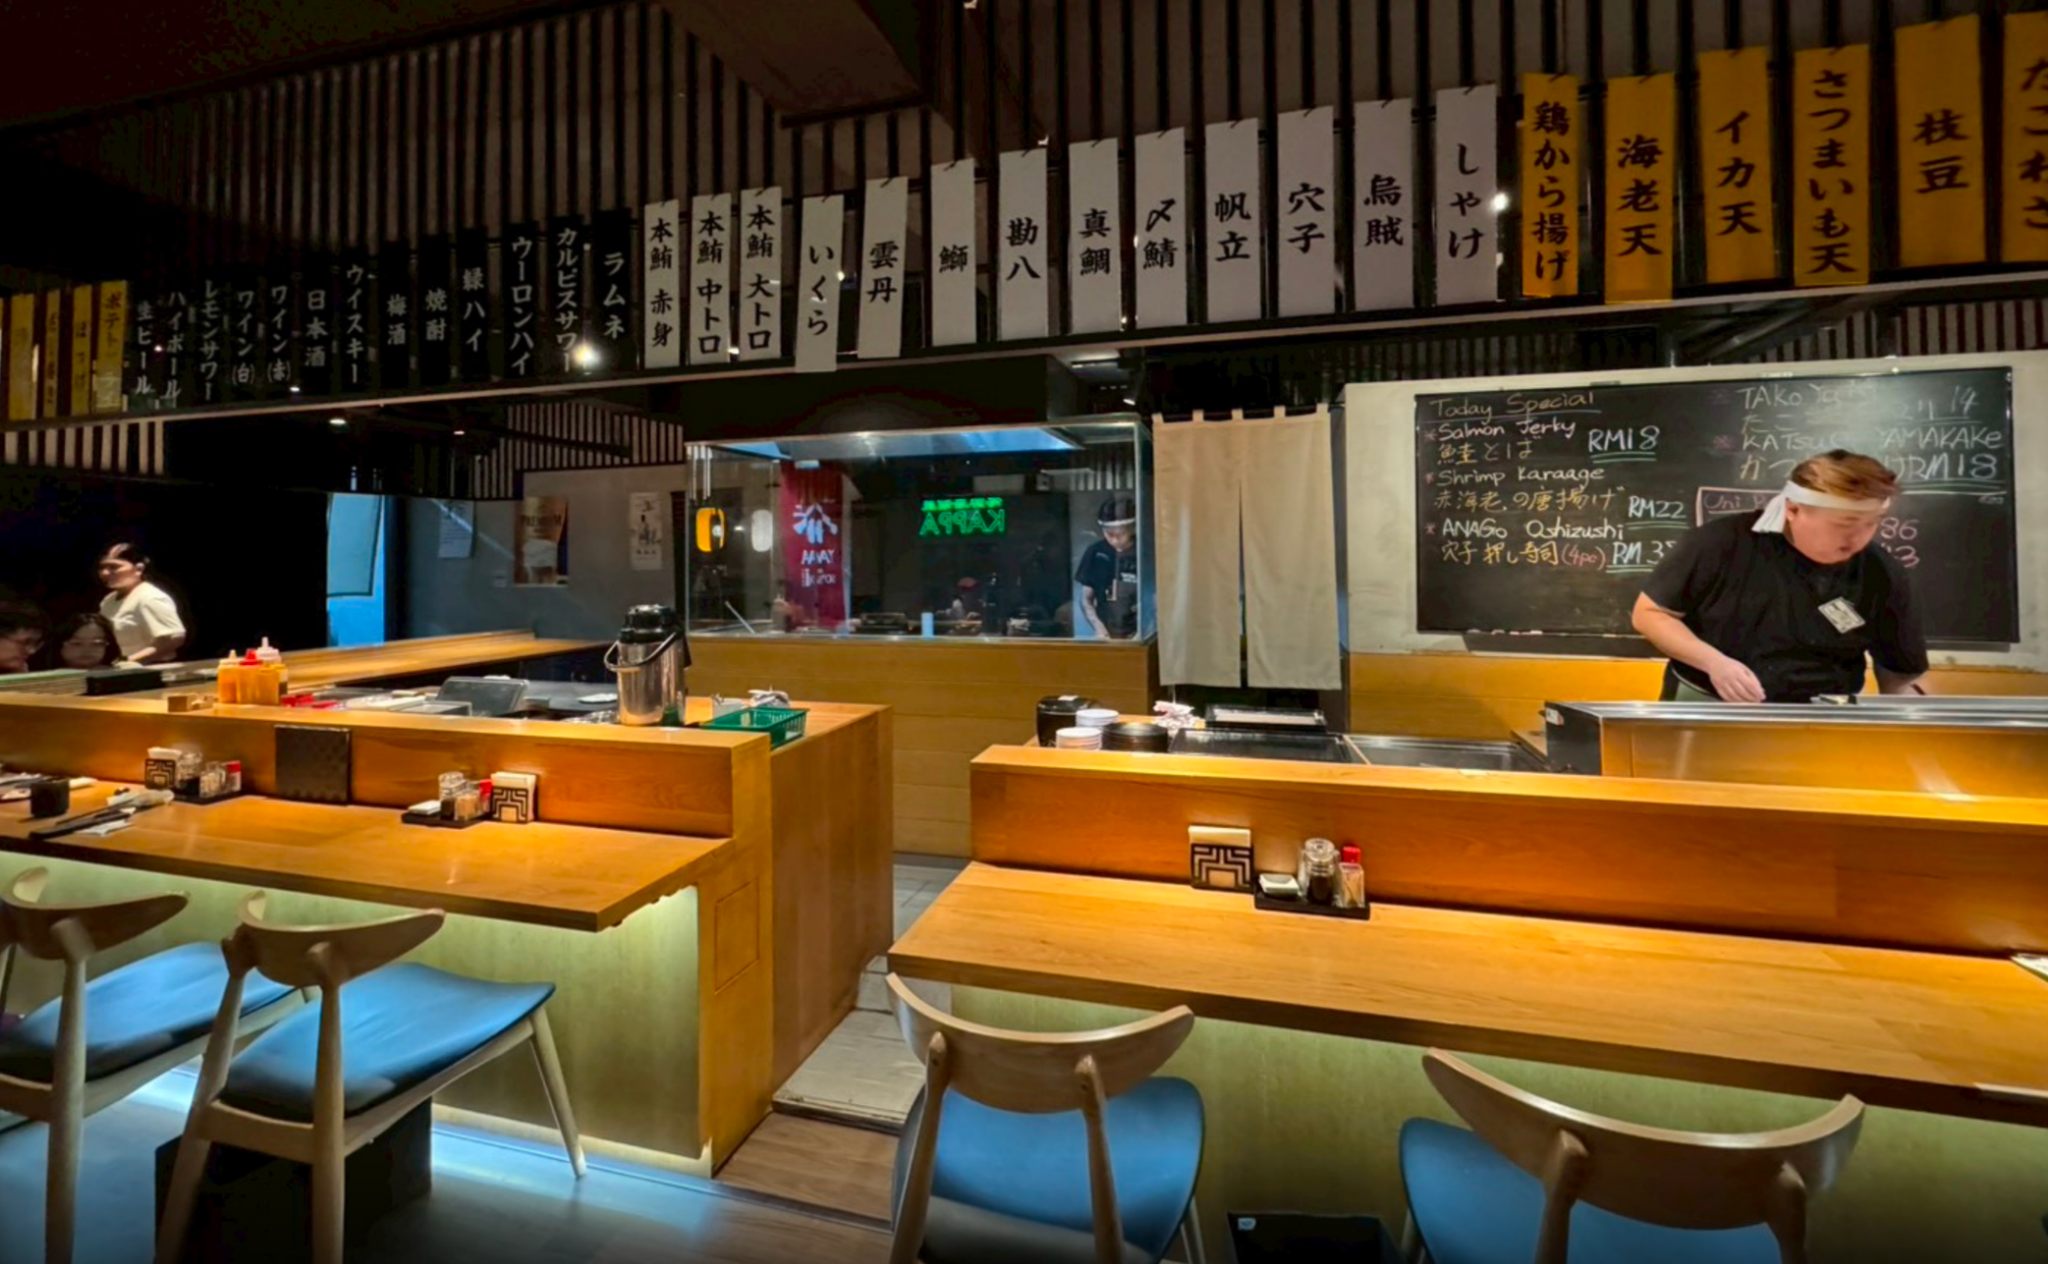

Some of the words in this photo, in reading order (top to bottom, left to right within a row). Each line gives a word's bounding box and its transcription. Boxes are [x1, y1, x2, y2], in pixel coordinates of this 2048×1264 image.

[1532, 100, 1570, 281] 鶏から揚げ
[1715, 110, 1763, 236] イカ天
[1807, 69, 1857, 275] さつまいも天
[1913, 109, 1970, 194] 枝豆
[1143, 198, 1178, 269] 〆鯖
[1215, 192, 1251, 262] 帆立
[1288, 182, 1325, 253] 穴子
[1364, 174, 1404, 247] 烏賊
[1617, 134, 1664, 257] 海老天
[866, 241, 898, 304] 雲丹
[1006, 217, 1041, 281] 勘八
[1078, 208, 1112, 275] 真鯛
[304, 289, 329, 367] 日本酒
[346, 264, 365, 383] ウイスキー
[425, 287, 448, 342] 焼酎
[509, 236, 535, 376] ウーロンハイ
[555, 227, 579, 372] カルピスサワー
[603, 252, 627, 340] ラムネ
[808, 246, 834, 336] いくら
[137, 299, 156, 396] 生ビール
[160, 291, 187, 402] ハイボール
[200, 279, 221, 401] レモンサワー
[1430, 399, 1493, 423] Today
[1507, 391, 1595, 419] Special
[1438, 421, 1505, 441] Salmon
[1516, 417, 1576, 439] Jerky
[1437, 469, 1506, 486] Shrimp
[1517, 467, 1605, 488] Karaage
[1628, 495, 1686, 518] RM22
